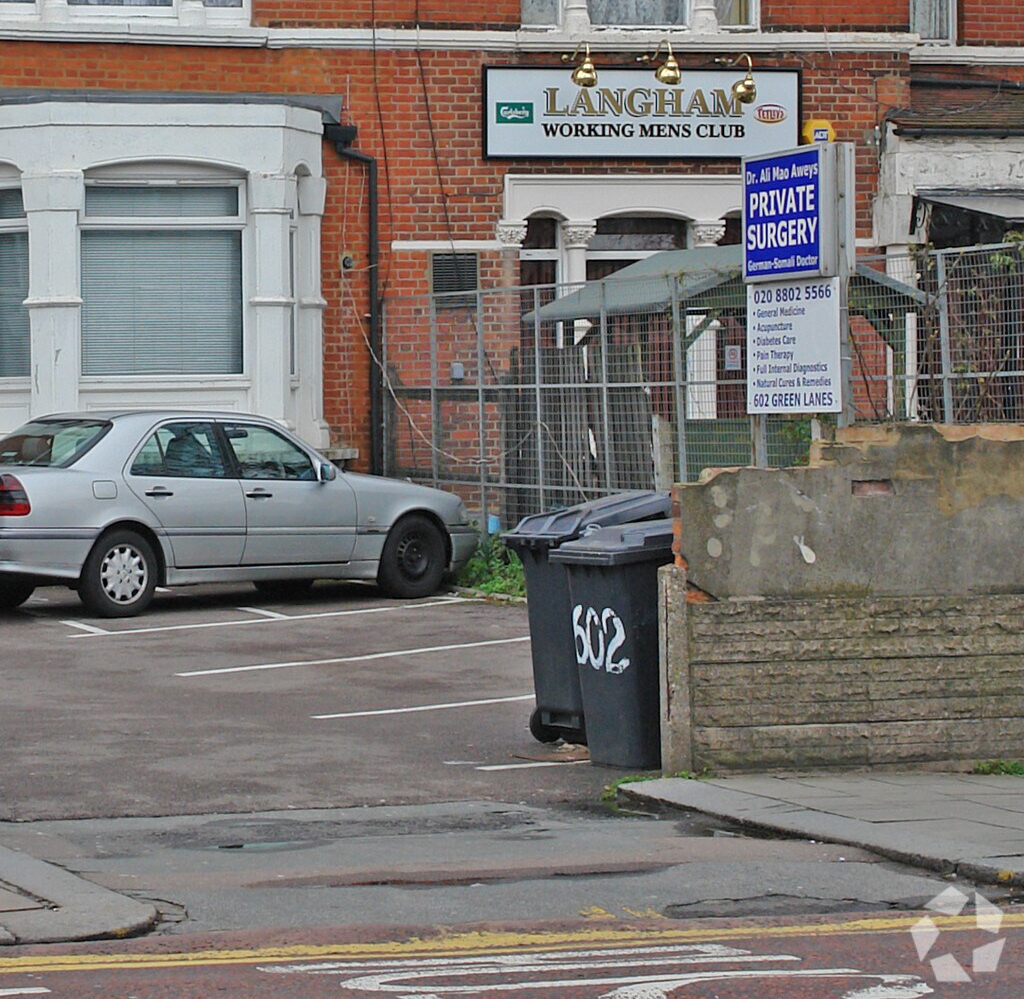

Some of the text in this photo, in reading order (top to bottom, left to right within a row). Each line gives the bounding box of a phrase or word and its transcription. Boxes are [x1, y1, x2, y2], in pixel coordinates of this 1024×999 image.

[542, 87, 745, 118] LANGHAM
[541, 123, 746, 139] WORKING MENS CLUB
[746, 162, 818, 185] Dr. Ali Mao Aweys
[749, 184, 815, 218] PRIVATE
[747, 217, 817, 251] SURGERY
[747, 254, 818, 272] German-Somali Doctor
[754, 284, 832, 304] 020 8802 5566
[756, 306, 805, 318] General Medicine
[756, 322, 793, 334] Acupuncture
[756, 335, 796, 346] Diabetes Care
[756, 350, 794, 361] Pain Therapy
[756, 362, 828, 375] Full Internal Diagnostics
[756, 377, 832, 388] Natural Cures & Remedies
[753, 392, 833, 407] 602 GREEN LANES
[572, 604, 630, 675] 602
